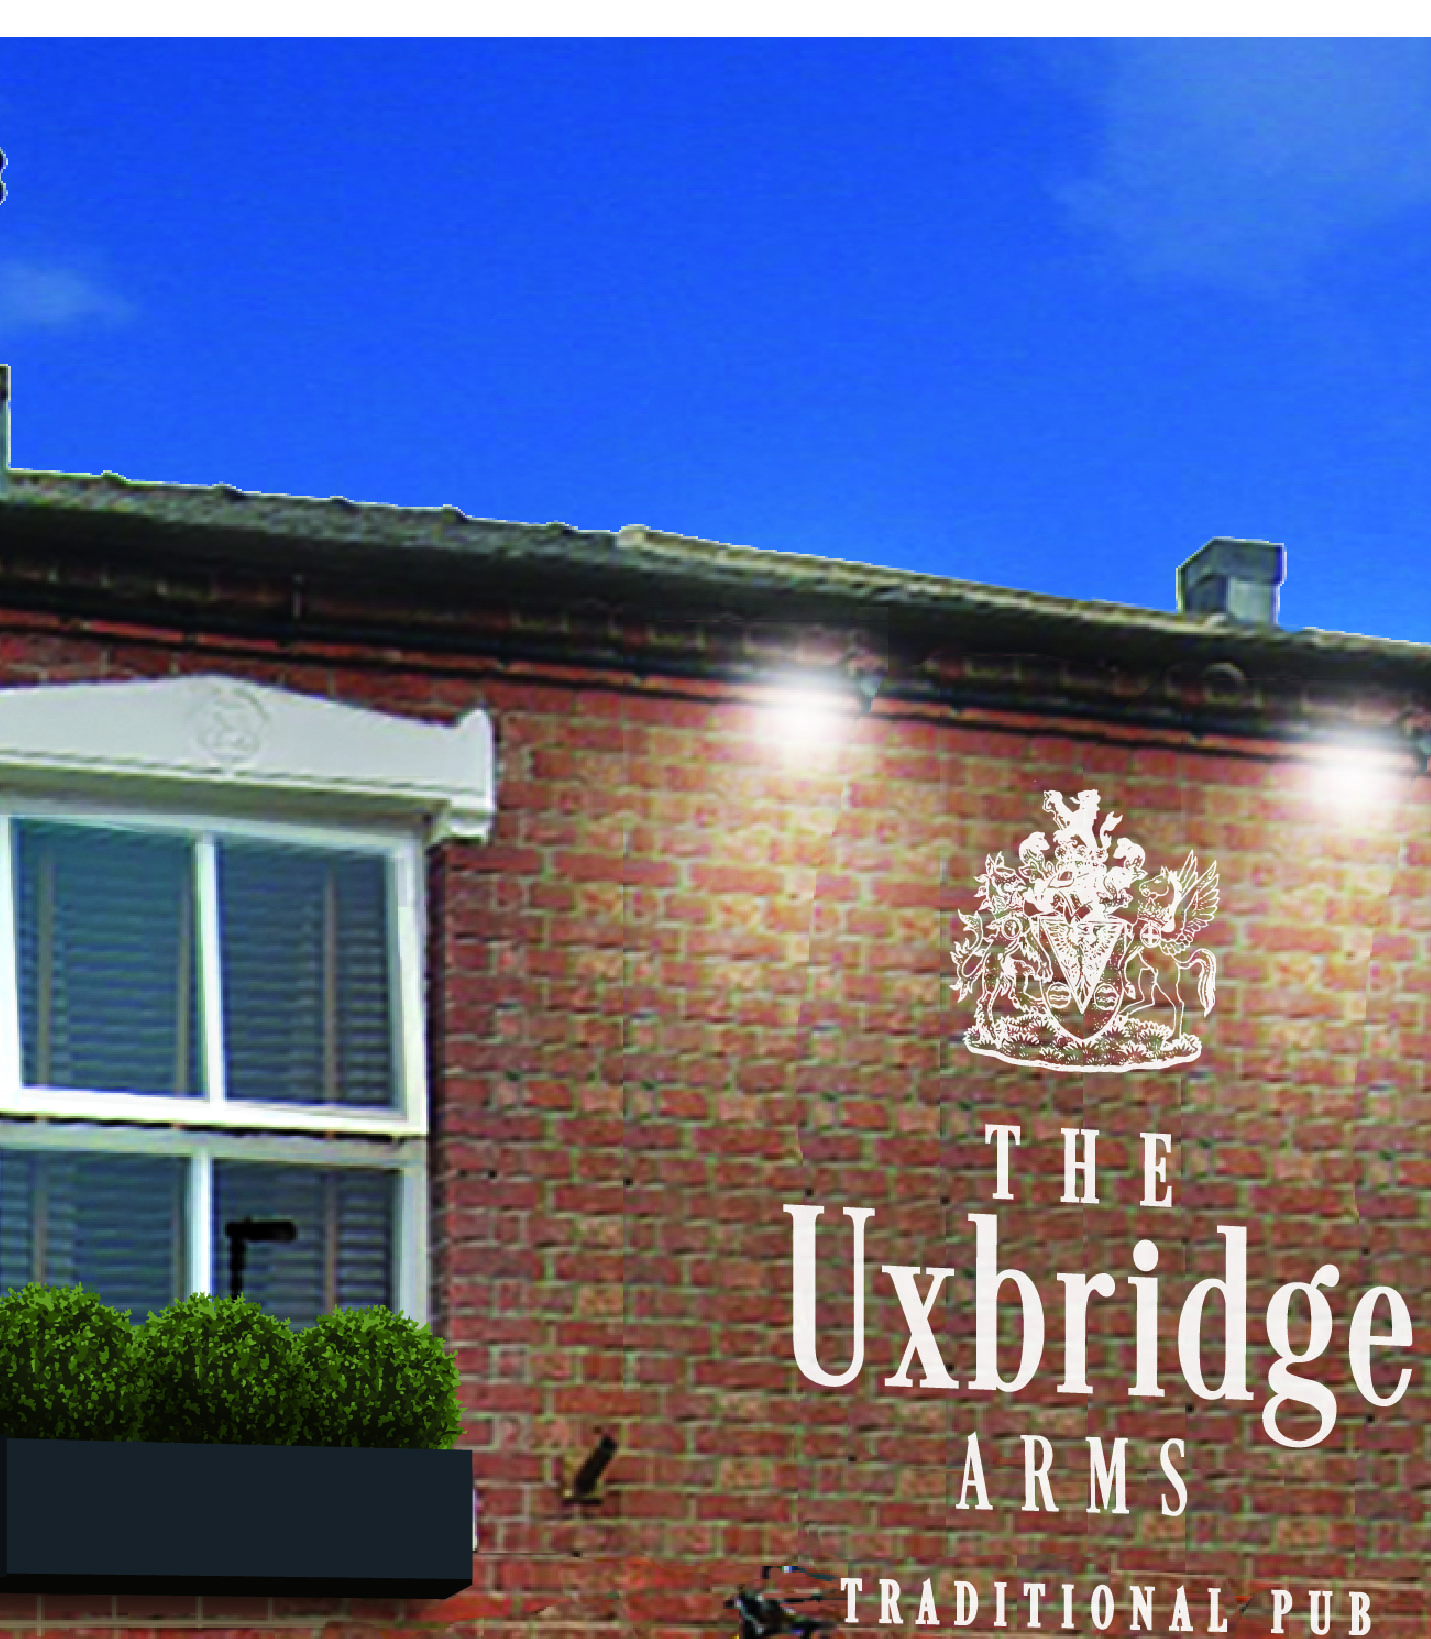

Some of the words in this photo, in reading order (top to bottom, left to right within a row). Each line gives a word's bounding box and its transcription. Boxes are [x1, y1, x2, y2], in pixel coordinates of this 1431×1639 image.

[984, 1124, 1172, 1208] THE
[783, 1204, 1413, 1447] Uxbridge
[956, 1432, 1188, 1516] ARMS
[840, 1577, 1228, 1633] TRADITIONAL
[1270, 1589, 1372, 1636] PUB
